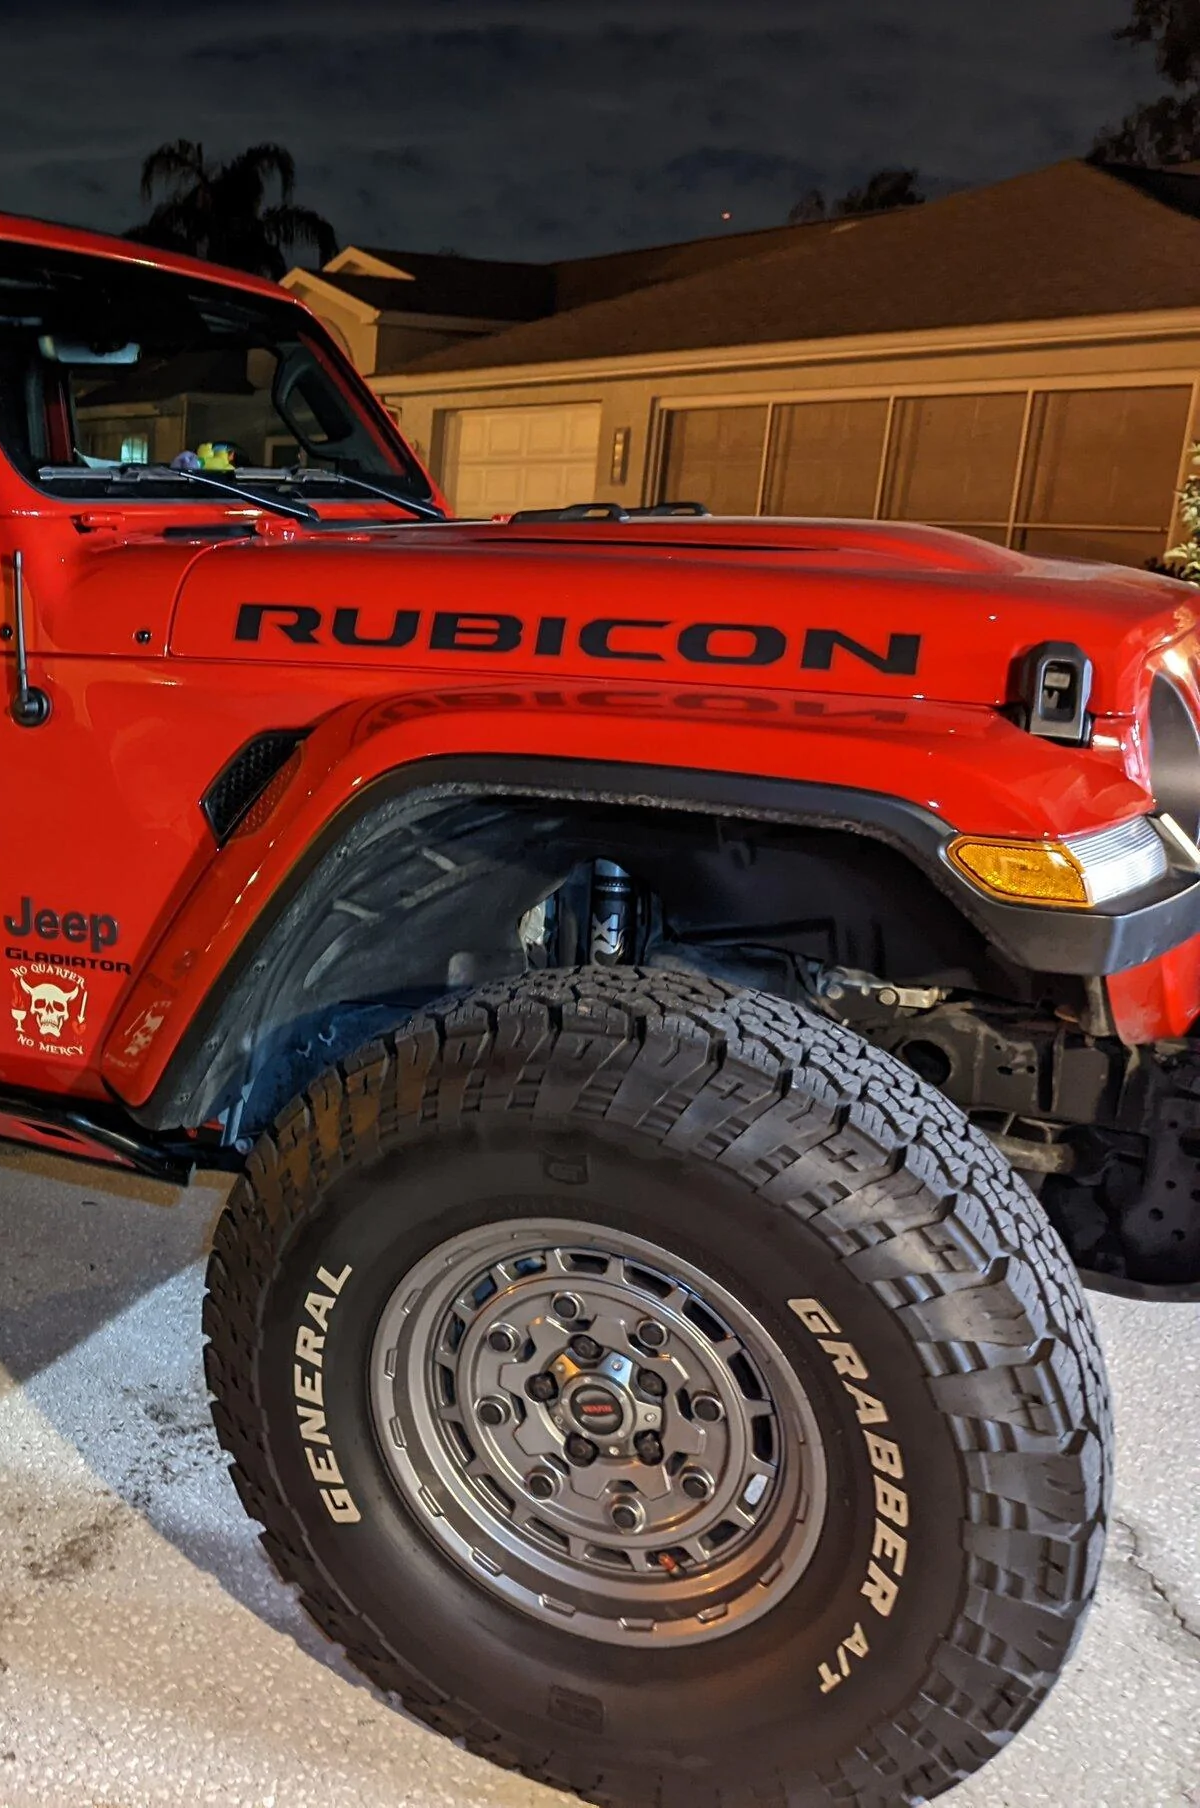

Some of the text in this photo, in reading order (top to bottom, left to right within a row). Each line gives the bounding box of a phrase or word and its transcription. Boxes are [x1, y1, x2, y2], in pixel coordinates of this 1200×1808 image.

[233, 603, 922, 676] RUBICON
[4, 896, 119, 952] Jeep
[5, 947, 132, 975] GLADIATOR
[10, 963, 85, 990] NO QUARTER
[17, 1034, 84, 1056] NO MERCY
[294, 1264, 361, 1523] GENERAL
[787, 1298, 909, 1694] GRABBER A/T
